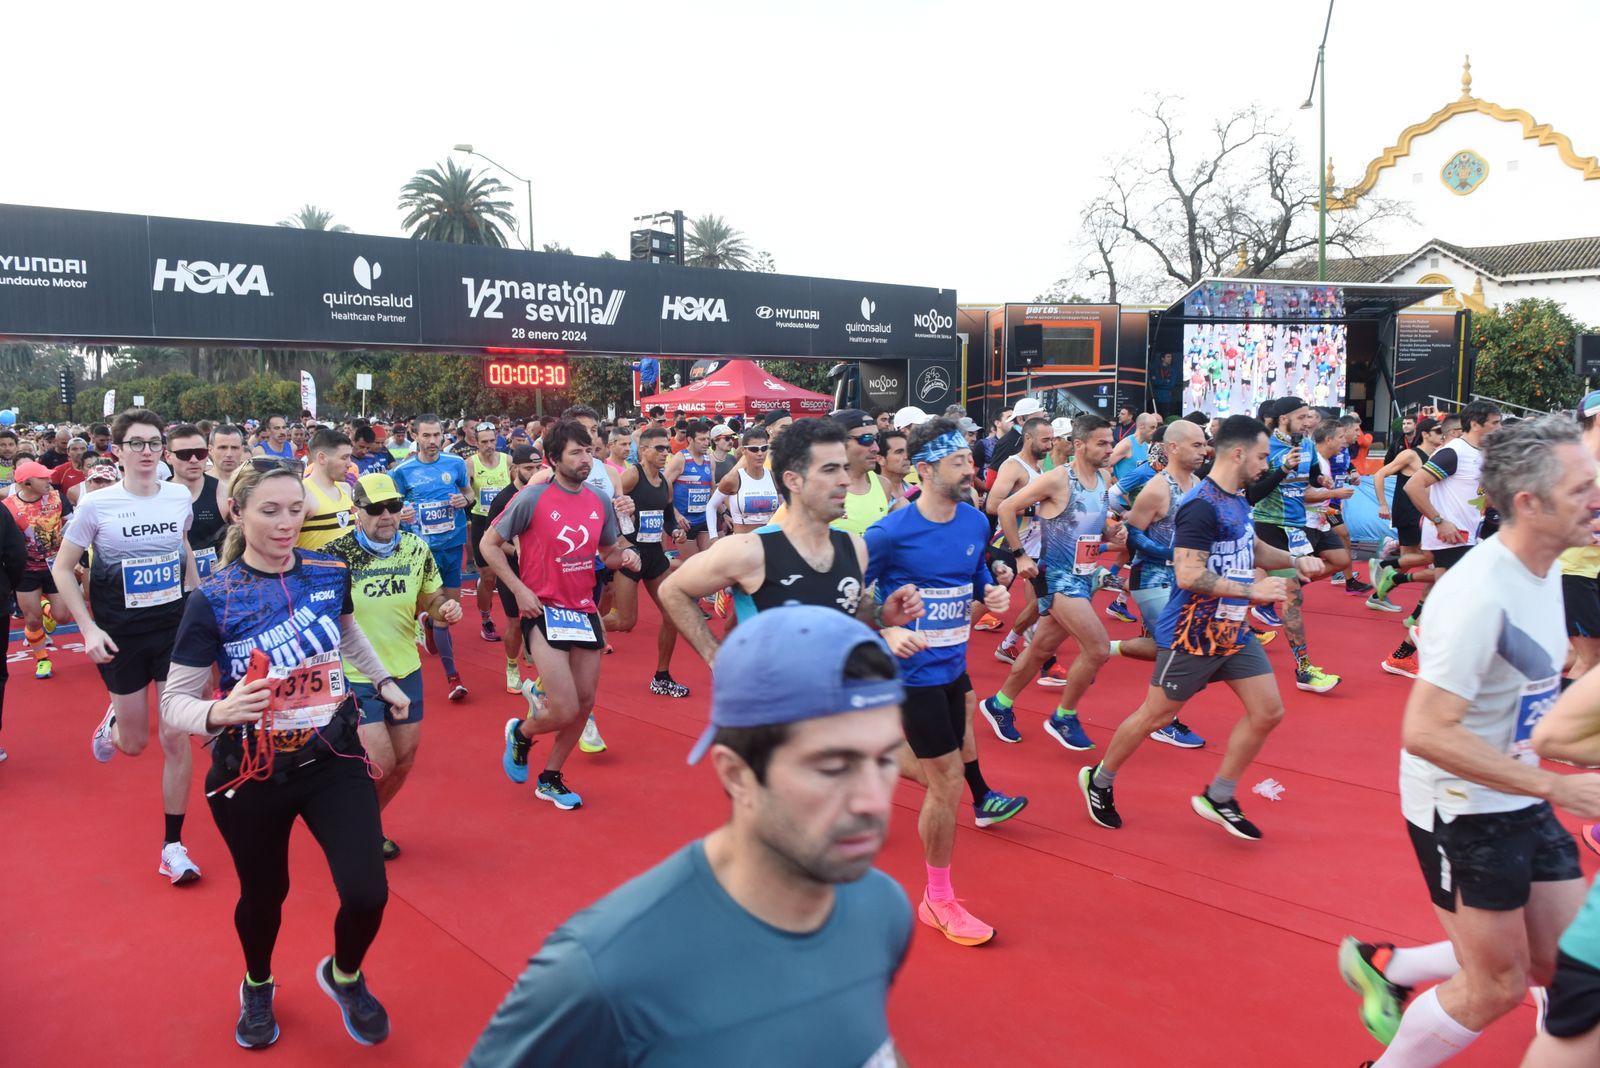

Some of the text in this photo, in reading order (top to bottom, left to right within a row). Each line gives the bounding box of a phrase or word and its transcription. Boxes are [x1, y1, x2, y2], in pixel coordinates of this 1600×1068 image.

[0, 255, 87, 274] YUNDAI
[0, 276, 87, 288] undauto Motor
[153, 258, 270, 296] HOKA
[495, 279, 603, 305] maratón
[525, 300, 605, 325] sevilla
[662, 295, 728, 322] HOKA
[775, 308, 820, 320] HYUNDAI
[331, 311, 406, 323] Healthcare Partner
[511, 327, 588, 341] 28 enero 2024
[489, 363, 566, 385] 00:00:30
[425, 509, 447, 520] 2902
[122, 522, 178, 537] LEPAPE
[645, 518, 661, 529] 1939
[197, 560, 206, 572] 7
[133, 566, 172, 586] 2019
[309, 589, 336, 603] HOKA
[363, 579, 407, 597] CXM
[551, 608, 581, 623] 3106
[927, 601, 964, 620] 2802
[258, 605, 317, 651] MARATÓN
